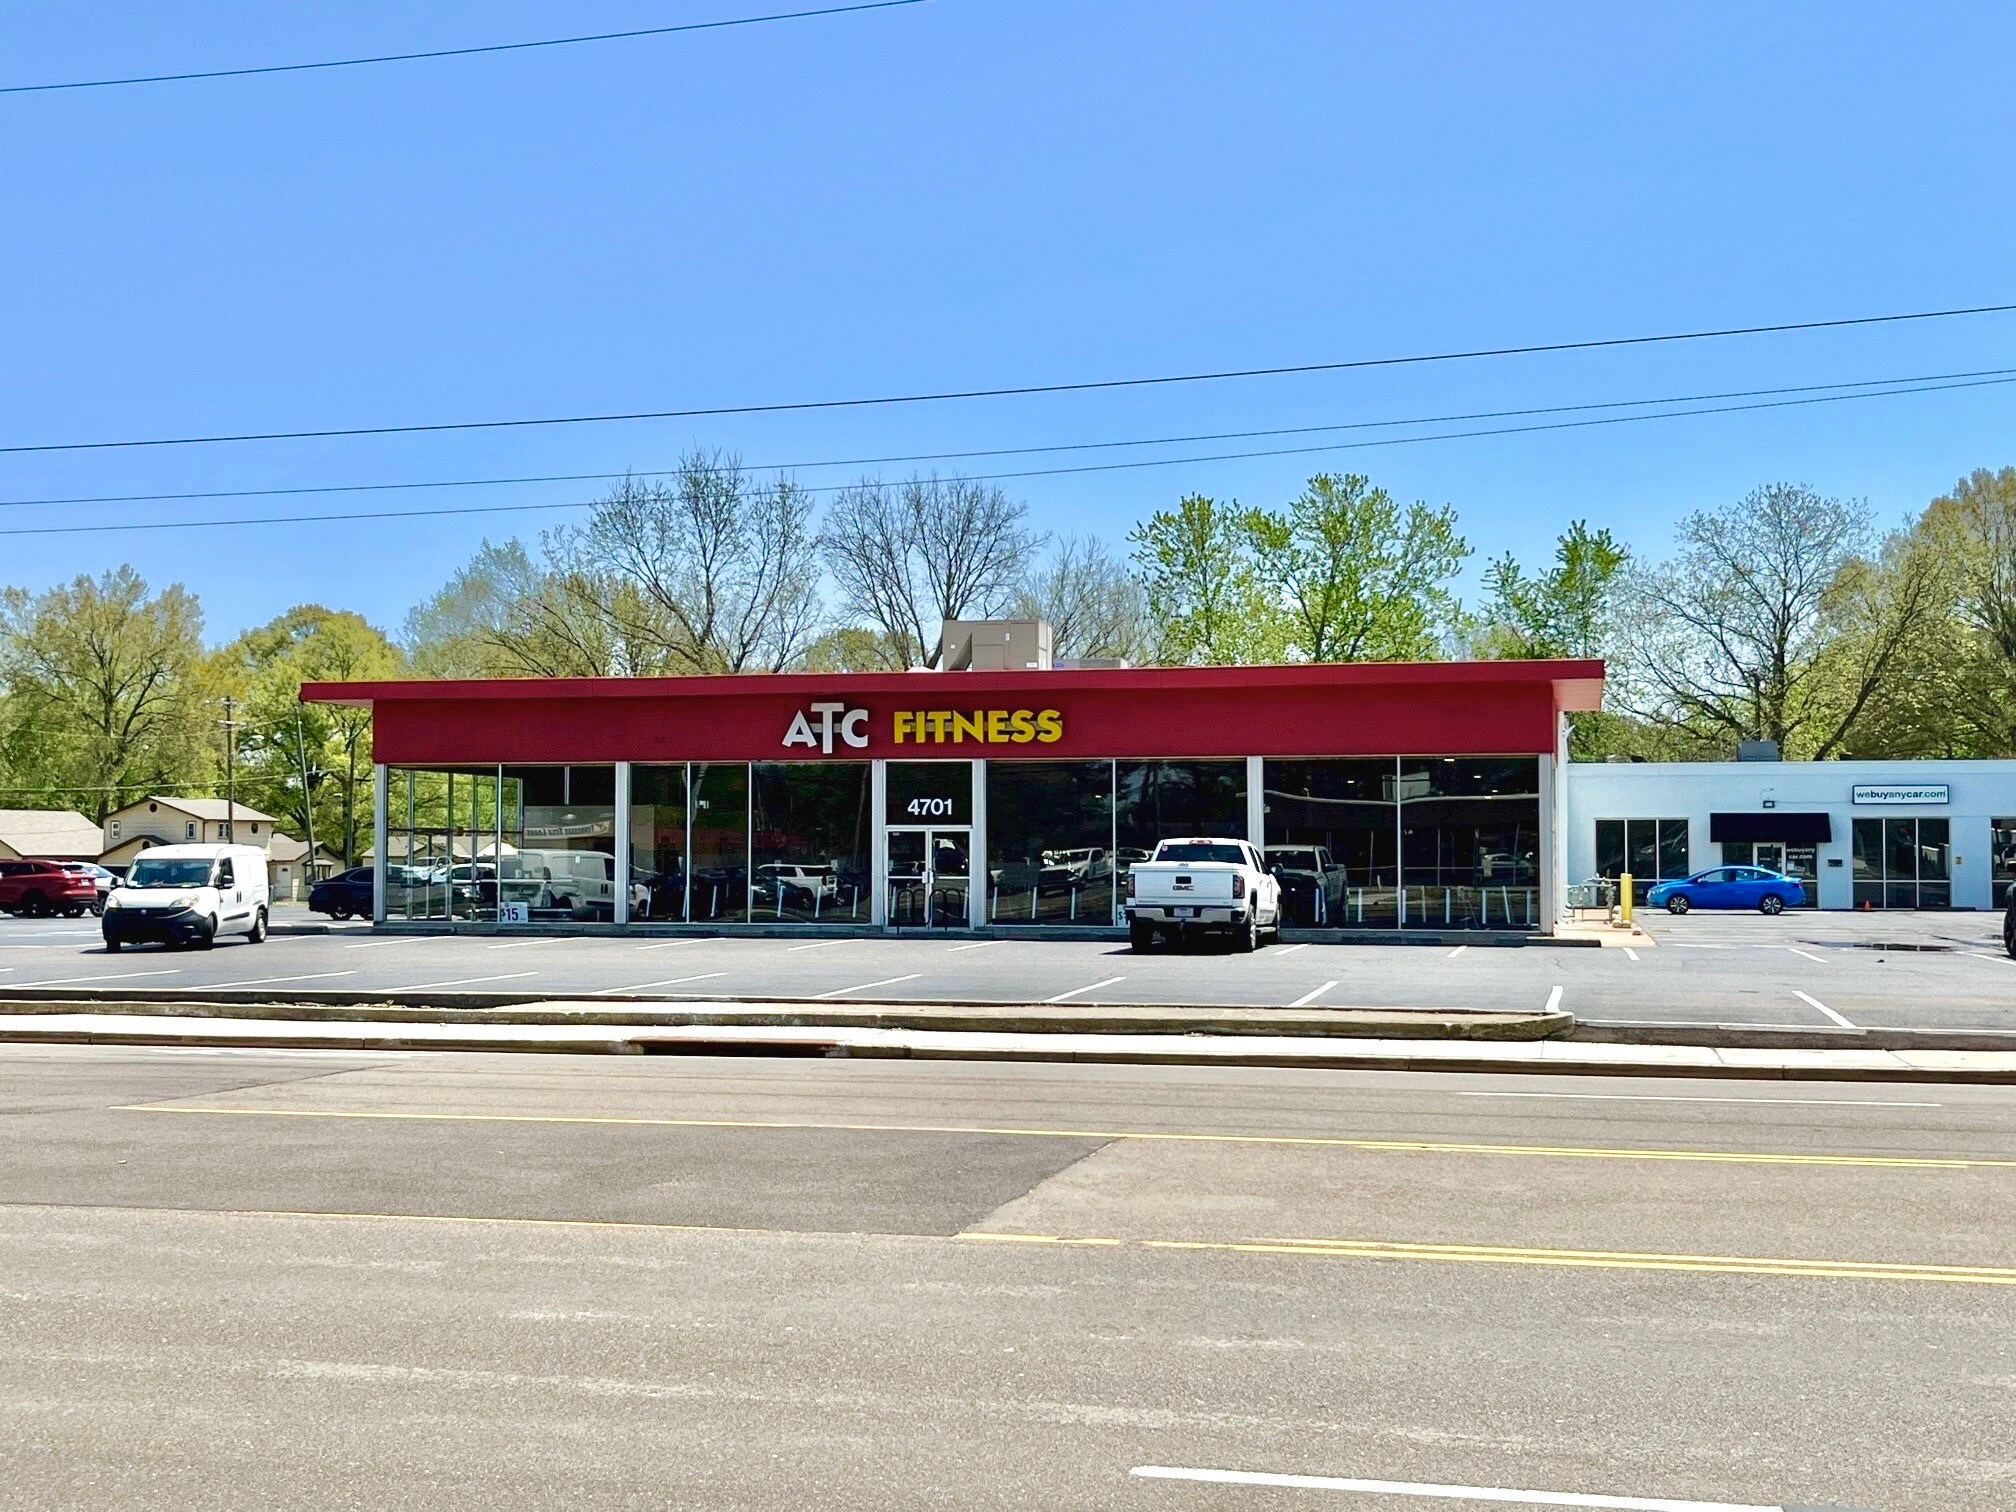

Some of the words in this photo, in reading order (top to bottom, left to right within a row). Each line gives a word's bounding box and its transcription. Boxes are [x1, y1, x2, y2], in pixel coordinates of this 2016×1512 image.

[782, 702, 868, 754] ATC
[894, 709, 1062, 744] FITNESS
[1856, 790, 1946, 799] webuyanycar.com
[907, 798, 952, 816] 4701
[501, 907, 519, 920] $15
